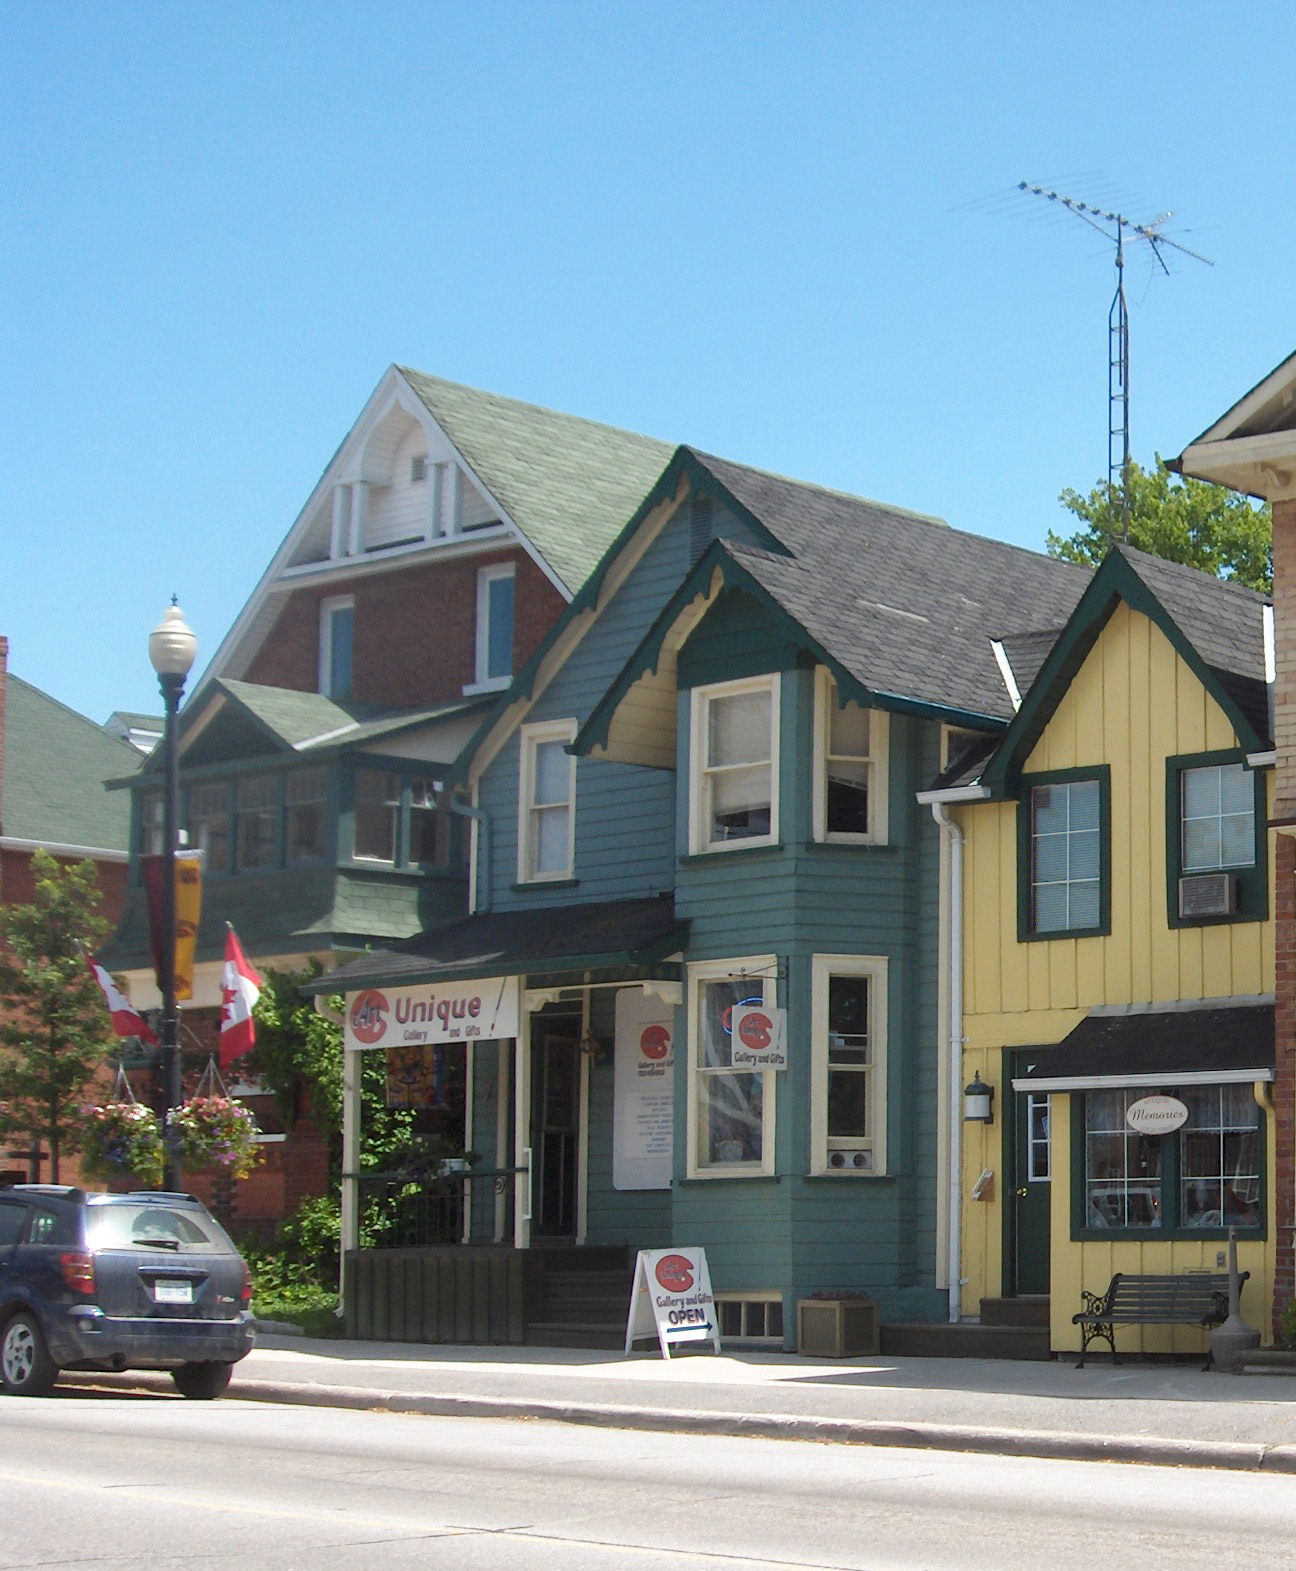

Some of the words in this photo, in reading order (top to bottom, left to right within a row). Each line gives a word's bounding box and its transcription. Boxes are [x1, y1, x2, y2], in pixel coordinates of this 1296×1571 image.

[395, 994, 481, 1031] Unique
[403, 1029, 428, 1042] Gallery
[449, 1027, 460, 1037] and
[465, 1026, 480, 1036] Gifts
[734, 1051, 757, 1066] Gallery
[758, 1054, 769, 1064] and
[770, 1053, 785, 1064] Gifts
[1130, 1108, 1184, 1121] Memories
[657, 1296, 685, 1309] Gallery
[686, 1294, 697, 1305] and
[698, 1293, 712, 1304] Gifts
[669, 1308, 705, 1325] OPEN
